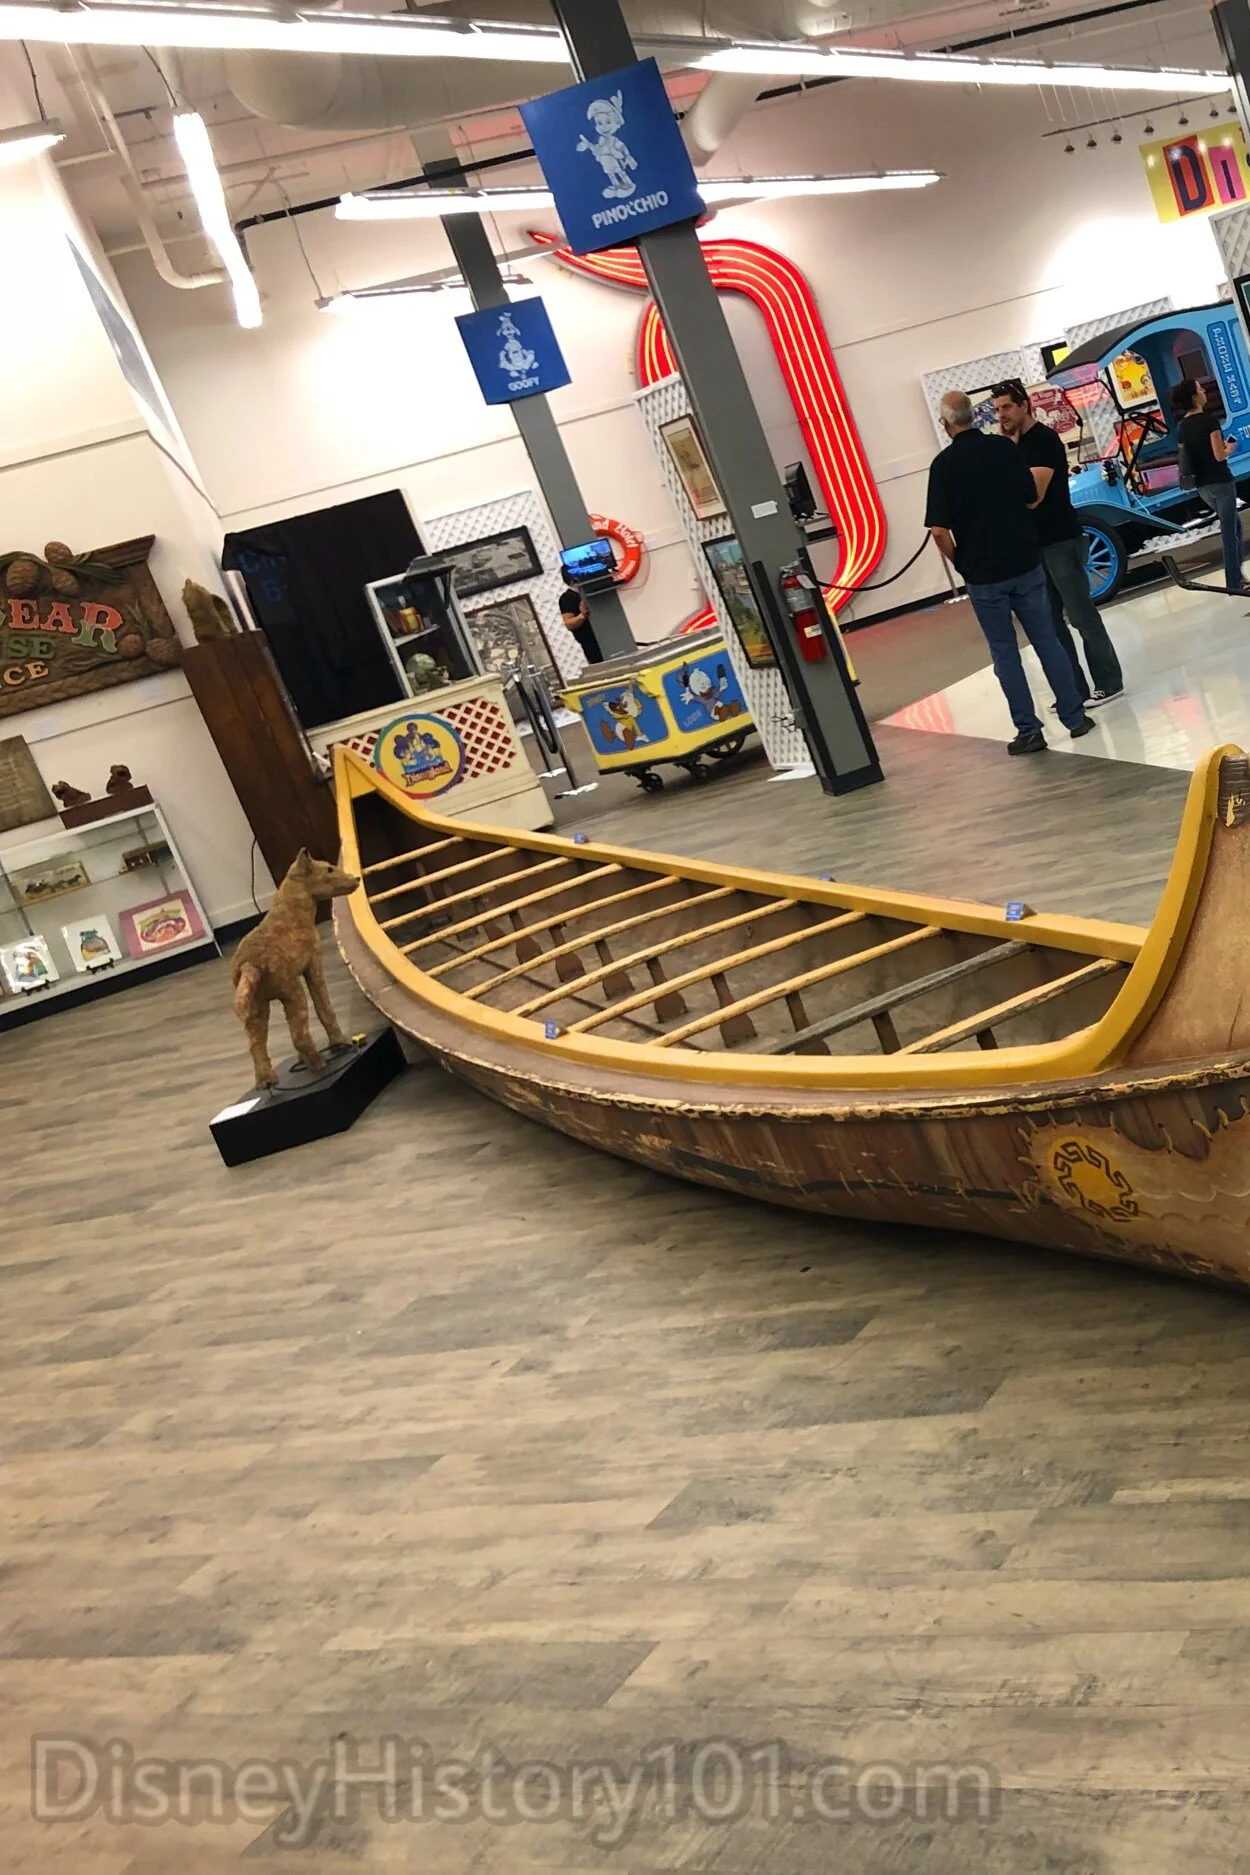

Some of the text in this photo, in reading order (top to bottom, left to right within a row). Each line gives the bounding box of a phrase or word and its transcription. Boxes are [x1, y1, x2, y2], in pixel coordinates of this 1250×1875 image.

[592, 190, 669, 229] PINOCCHIO
[508, 376, 540, 391] GOOFY
[0, 599, 124, 654] EAR
